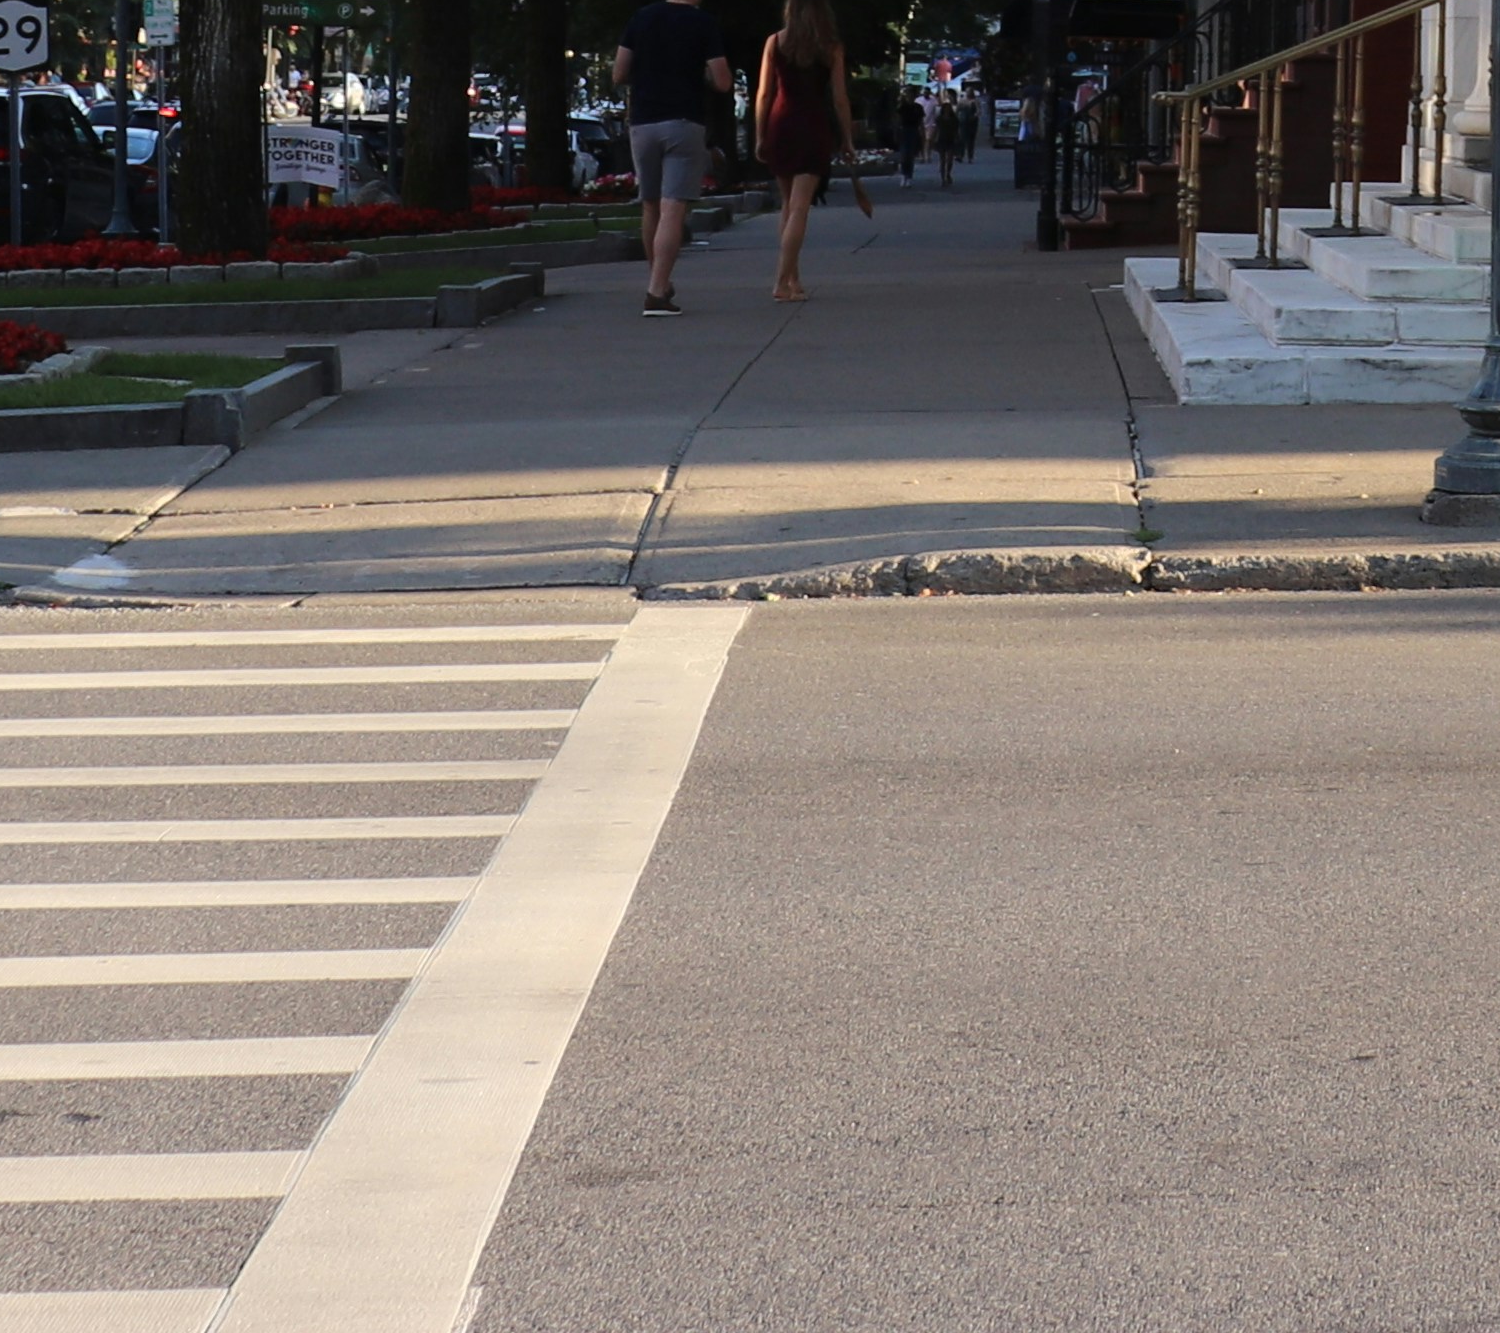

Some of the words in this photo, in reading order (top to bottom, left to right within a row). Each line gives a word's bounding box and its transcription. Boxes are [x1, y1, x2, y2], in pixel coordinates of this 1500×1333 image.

[262, 4, 309, 19] Parking
[268, 137, 335, 152] TRONGER
[268, 150, 335, 165] OGETHER
